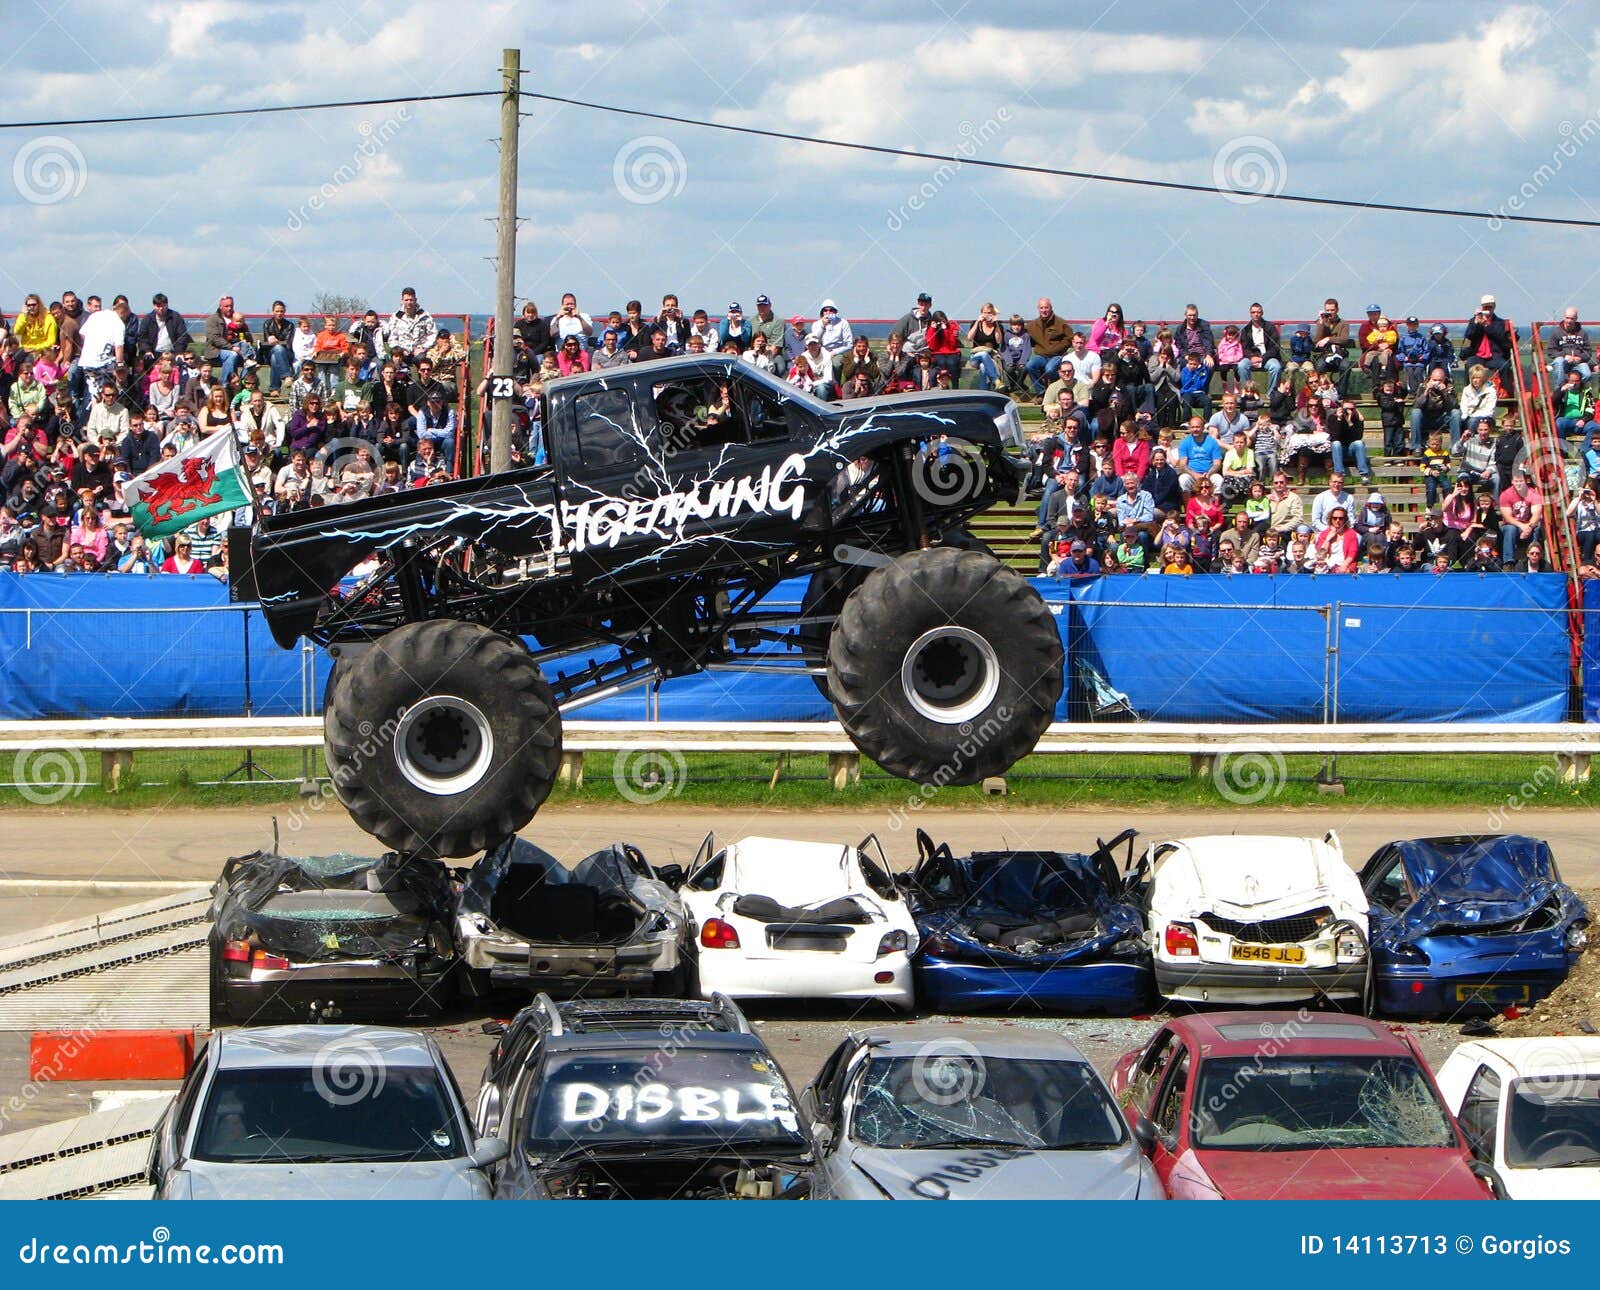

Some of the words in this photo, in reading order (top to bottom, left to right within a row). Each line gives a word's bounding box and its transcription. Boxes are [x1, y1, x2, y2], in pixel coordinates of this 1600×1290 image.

[492, 377, 514, 397] 23
[551, 453, 806, 553] LIGHTNING
[1232, 945, 1270, 960] M546
[1275, 948, 1303, 962] JLJ
